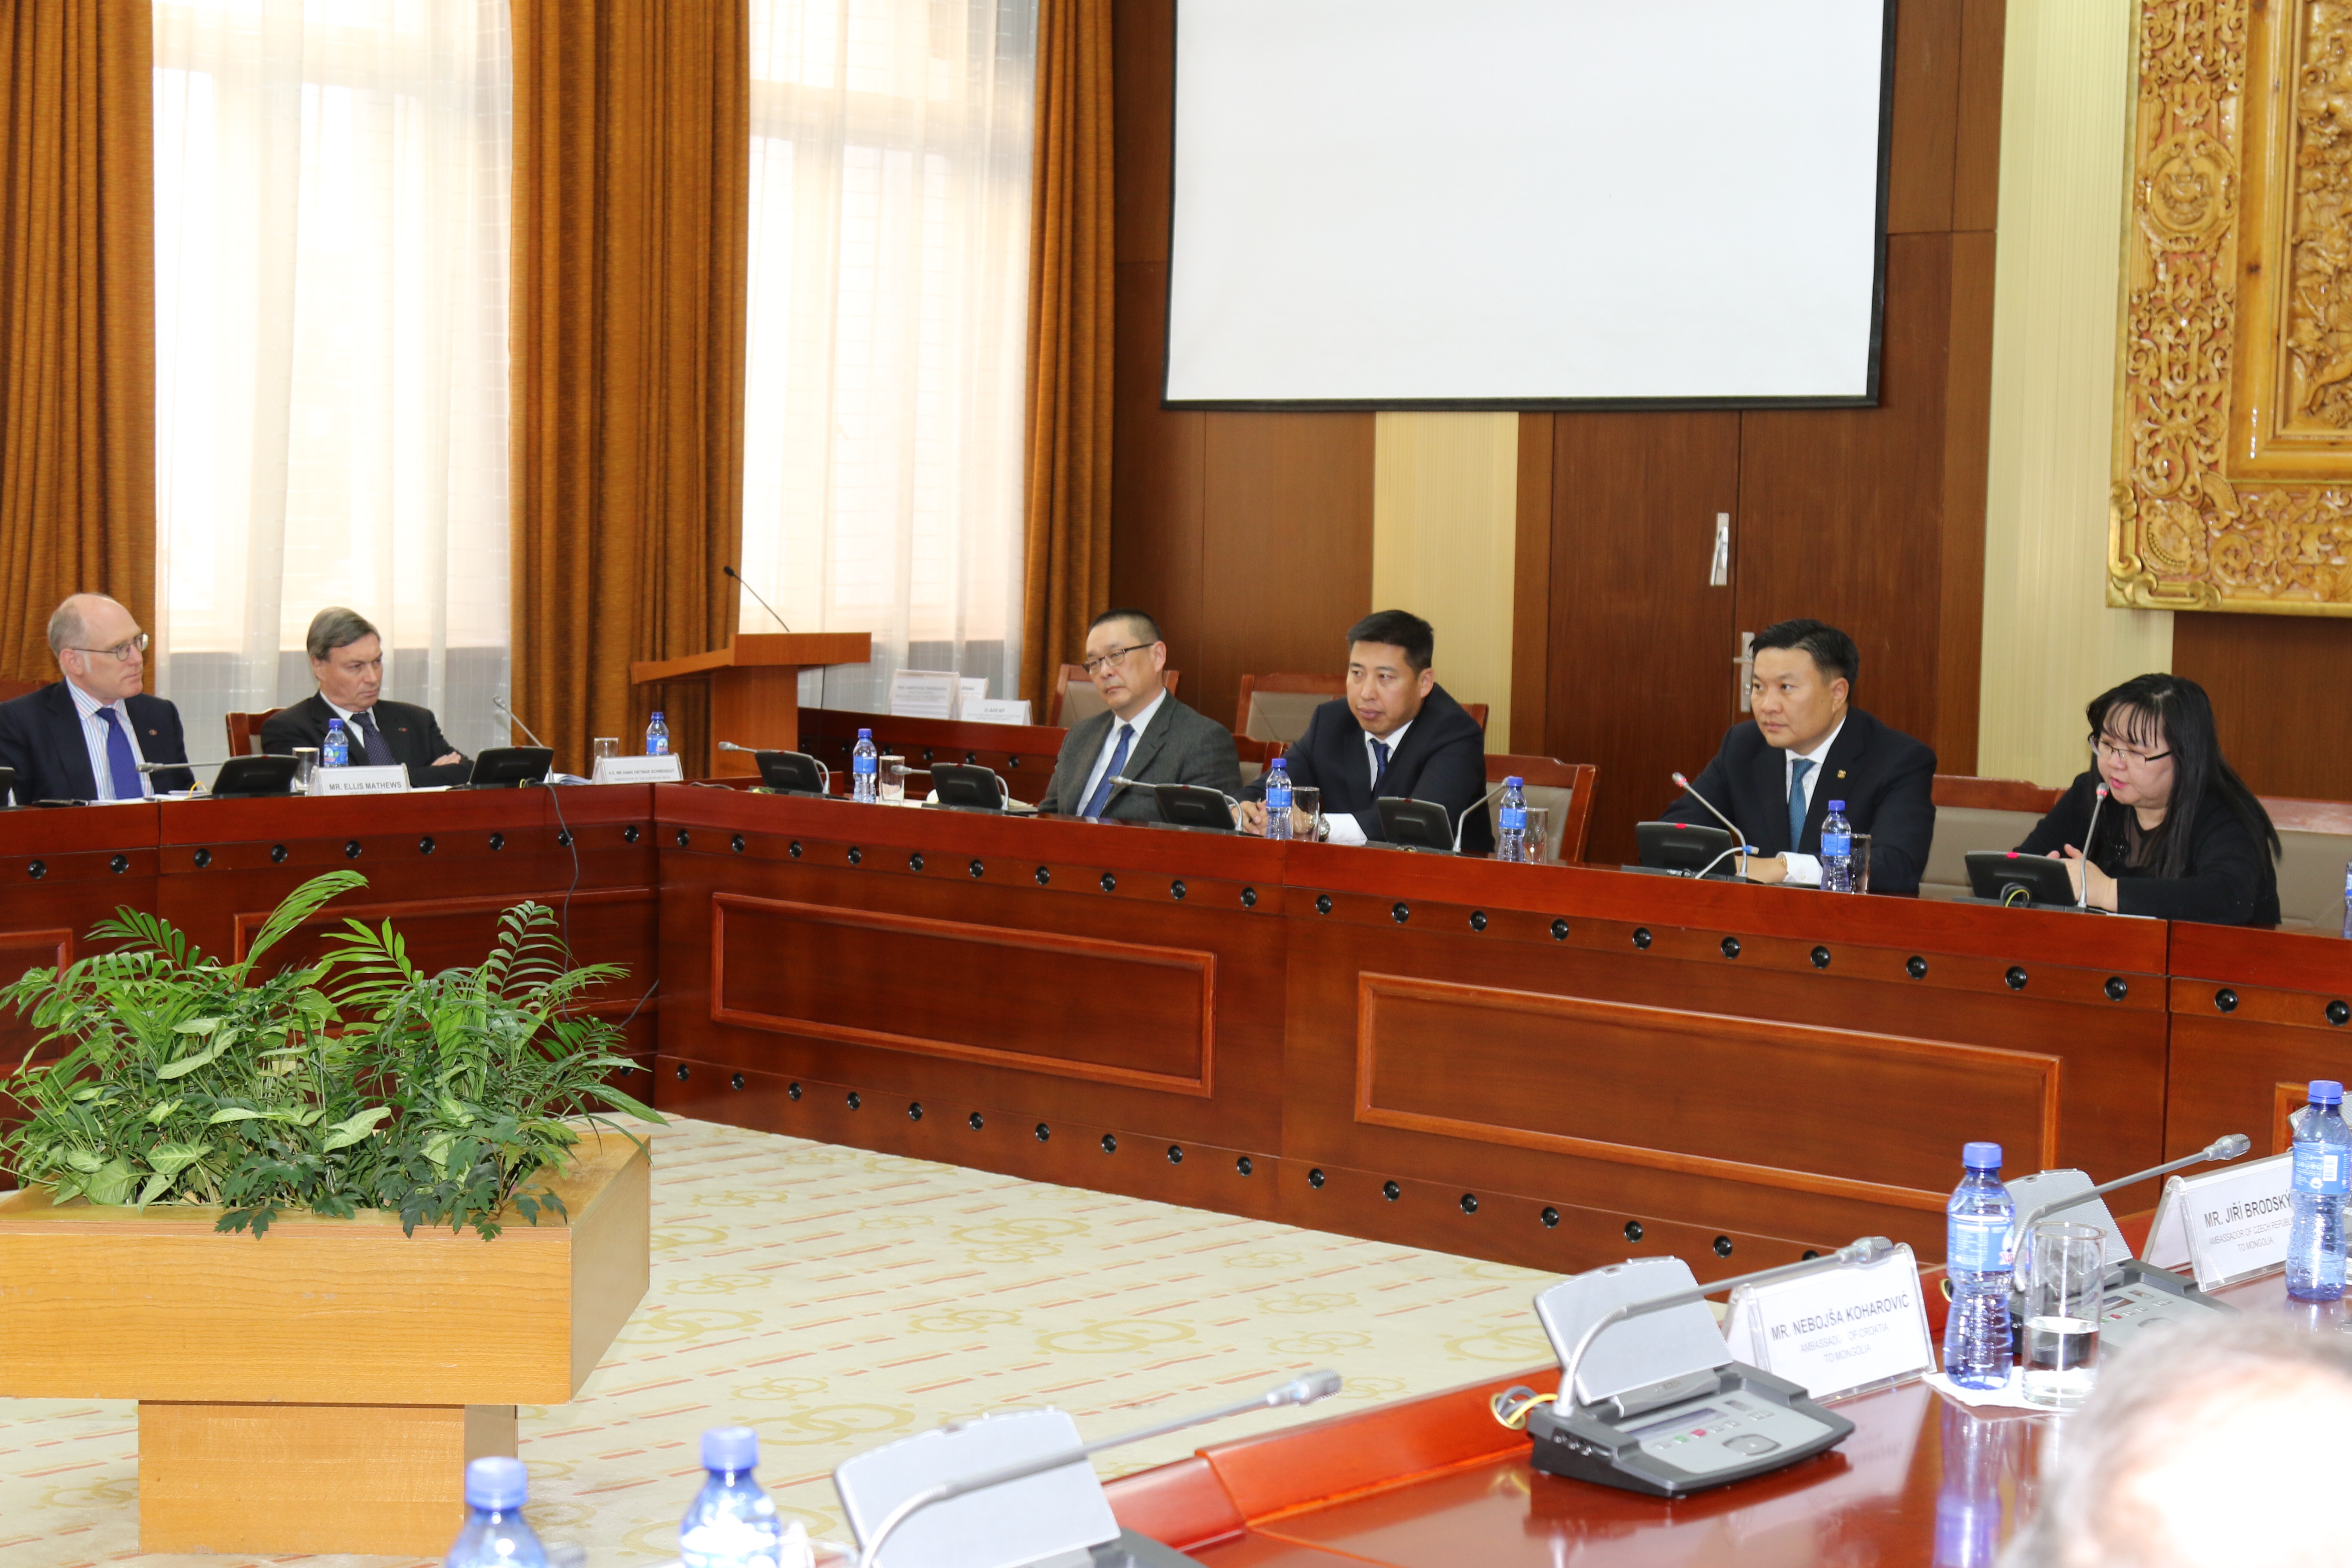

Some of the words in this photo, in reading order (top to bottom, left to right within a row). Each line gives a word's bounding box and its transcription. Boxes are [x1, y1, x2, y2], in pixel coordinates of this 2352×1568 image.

[365, 781, 402, 790] MATHEWS
[2204, 1211, 2223, 1228] MR.
[2225, 1200, 2244, 1223] JIŘÍ
[2245, 1189, 2291, 1218] BRODSKÝ
[2209, 1229, 2245, 1246] AMBASSADOR
[2245, 1227, 2253, 1236] OF
[2253, 1222, 2272, 1234] CZECH
[2237, 1243, 2246, 1252] TO
[2246, 1236, 2274, 1250] MONGOLIA
[1771, 1325, 1792, 1341] MR.
[1792, 1308, 1845, 1336] NEBOJŠA
[1801, 1333, 1844, 1354] AMBASSADO
[1849, 1329, 1859, 1341] OF
[1859, 1322, 1890, 1338] CROATIA
[1824, 1353, 1834, 1363] TO
[1836, 1344, 1872, 1360] MONGOLIA
